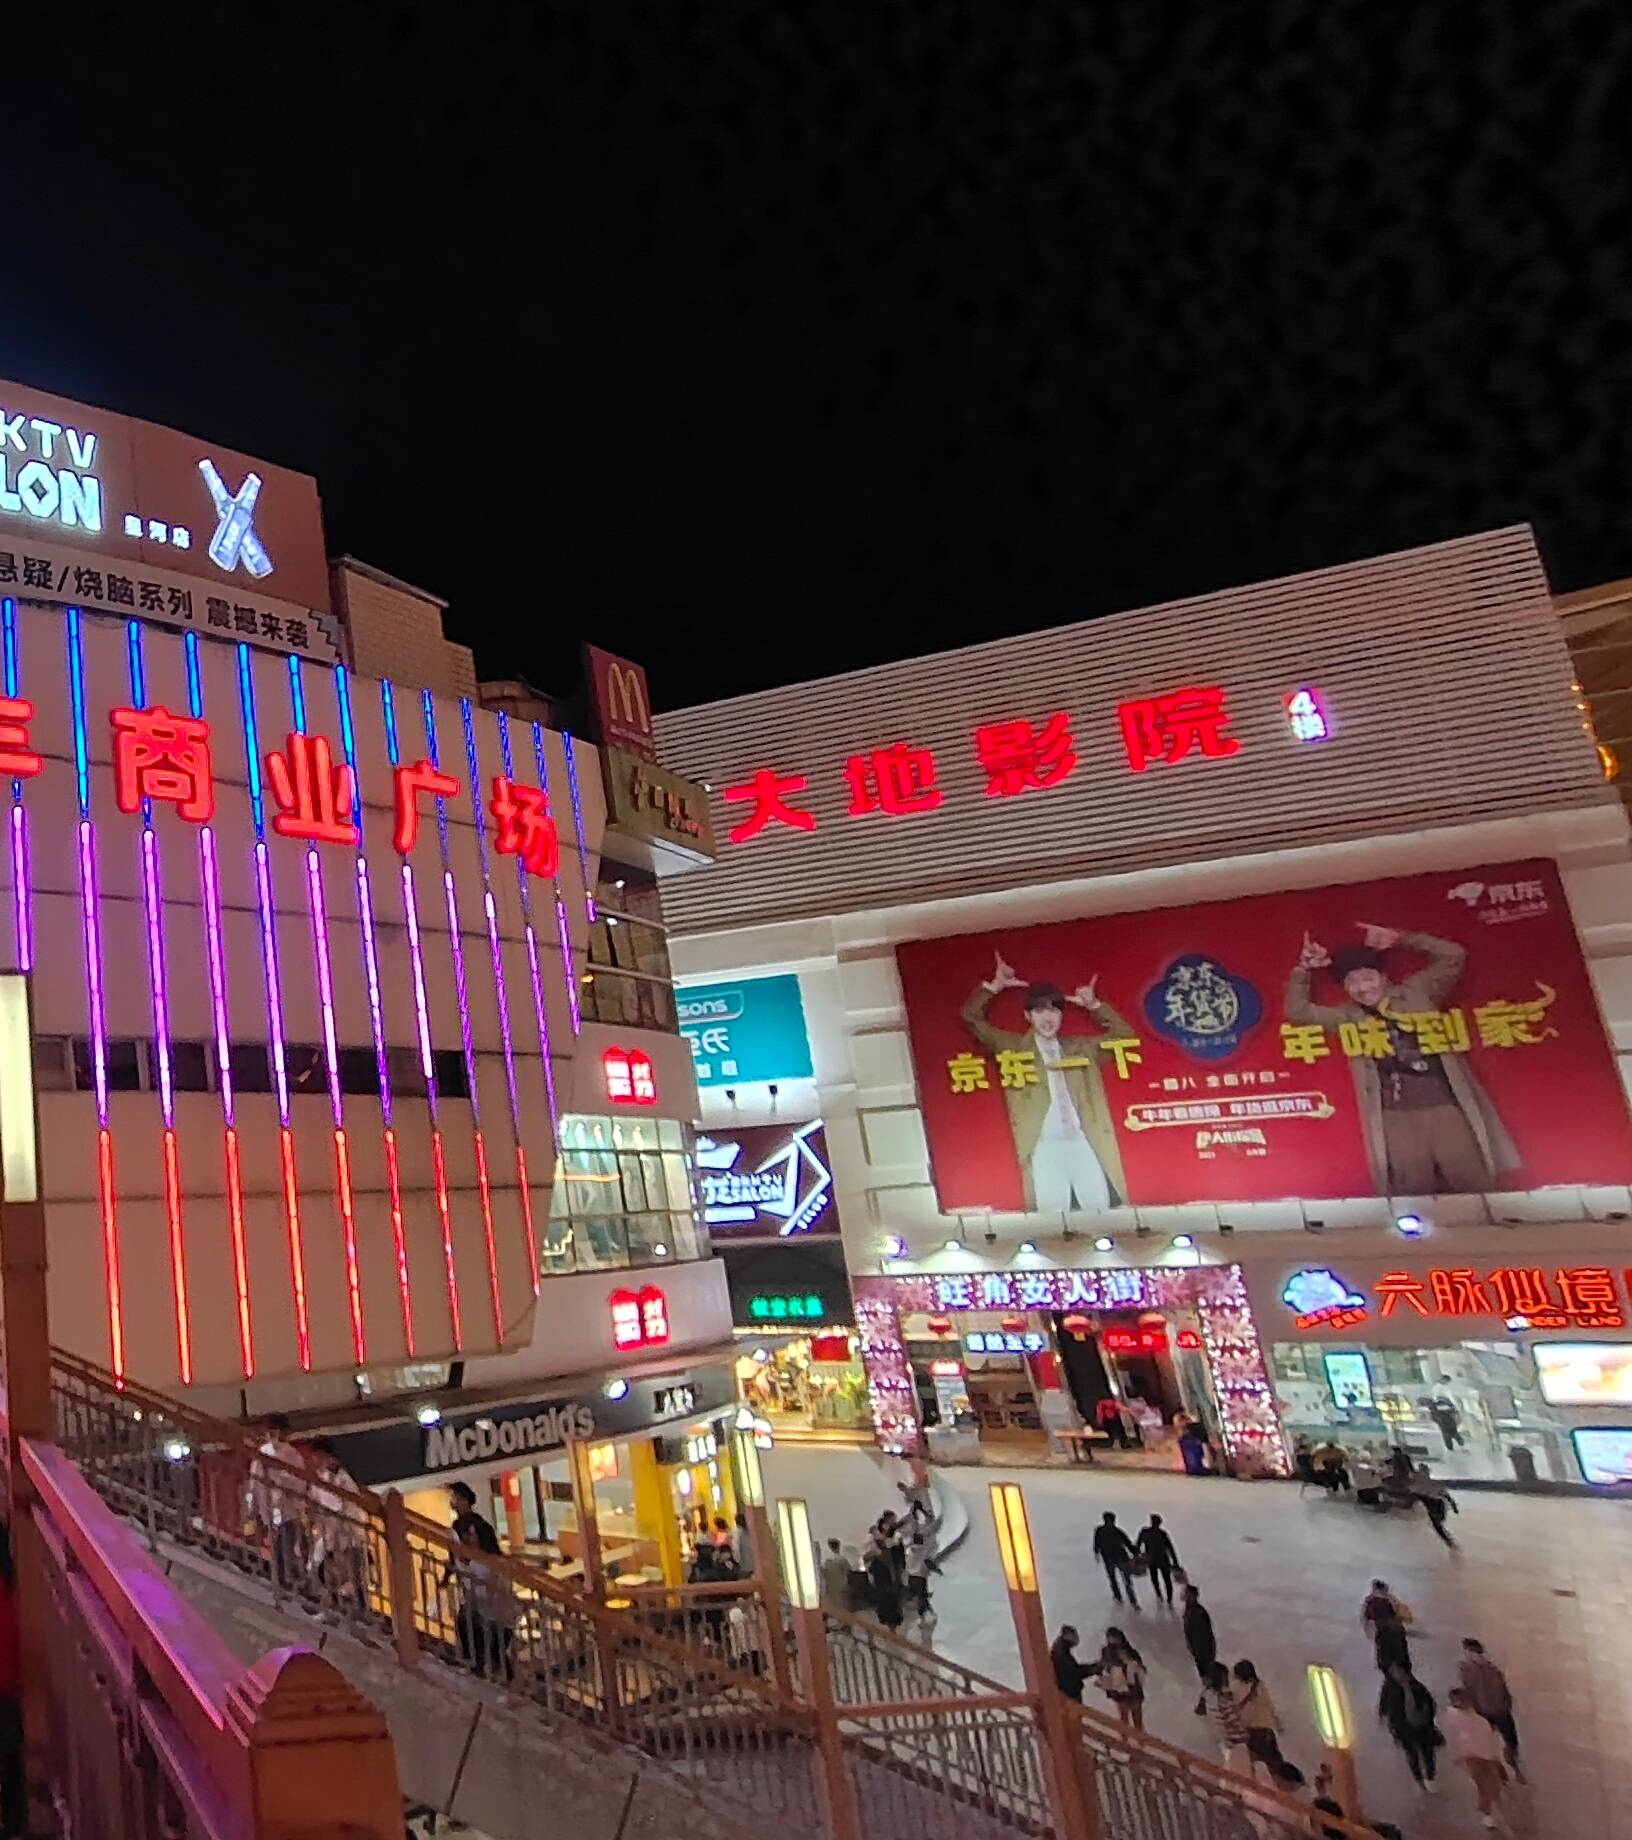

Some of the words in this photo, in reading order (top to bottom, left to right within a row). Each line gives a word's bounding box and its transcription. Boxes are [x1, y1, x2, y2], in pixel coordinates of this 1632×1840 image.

[206, 596, 310, 649] 震撼来袭
[724, 686, 1240, 844] 大地影院
[1489, 881, 1544, 905] 京东
[1280, 984, 1558, 1064] 年味到家
[947, 1037, 1142, 1093] 京东一下
[938, 1273, 1145, 1305] 旺角女人街
[1373, 1267, 1620, 1317] 六脉仙境
[424, 1403, 597, 1469] McDonald's
